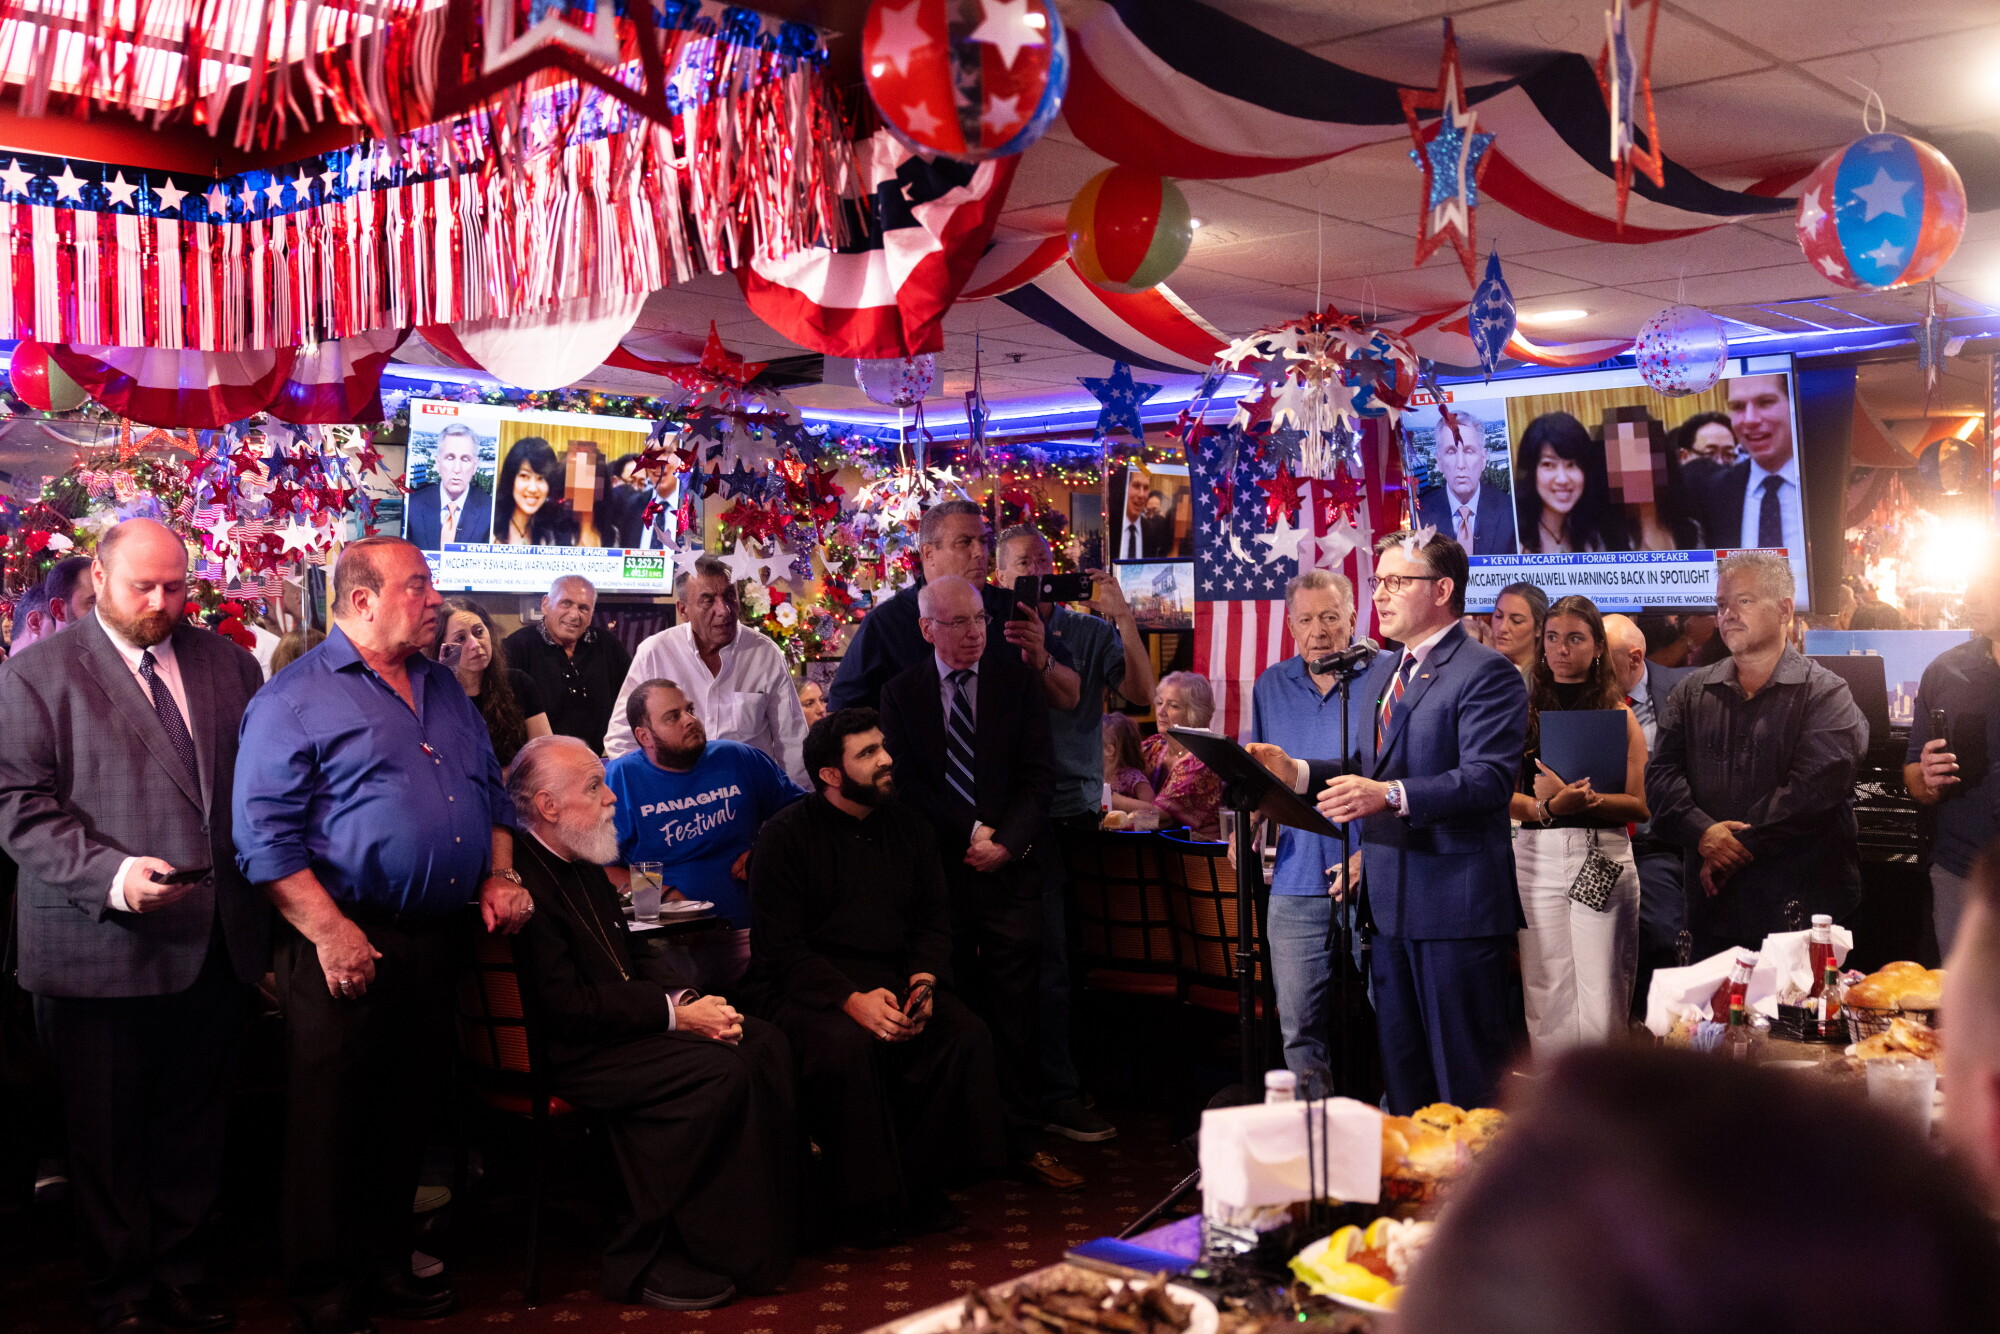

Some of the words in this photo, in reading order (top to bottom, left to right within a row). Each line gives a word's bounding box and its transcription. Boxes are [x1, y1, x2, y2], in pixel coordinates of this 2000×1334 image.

[426, 405, 455, 415] LIVE
[467, 544, 490, 553] KEVIN
[492, 545, 532, 554] MCCARTHY
[538, 547, 561, 555] FORMER
[562, 548, 582, 556] HOUSE
[583, 549, 608, 557] SPEAKER
[626, 558, 663, 569] 53,252.72
[1491, 556, 1519, 565] KEVIN
[1522, 555, 1574, 564] MCCARTHY
[1582, 554, 1616, 563] FORMER
[1619, 553, 1649, 562] HOUSE
[1651, 553, 1689, 562] SPEAKER
[489, 559, 522, 570] SWALWELL
[525, 560, 559, 571] WARNINGS
[561, 561, 578, 572] BACK
[581, 562, 587, 572] IN
[588, 562, 619, 573] SPOTLIGHT
[1468, 573, 1519, 586] MCCARTHY'S
[1521, 572, 1566, 586] SWALWELL
[1568, 571, 1618, 585] WARNINGS
[1621, 571, 1645, 585] BACK
[1648, 571, 1658, 585] IN
[1660, 570, 1710, 584] SPOTLIGHT
[1479, 597, 1497, 605] DRIN
[1684, 595, 1717, 603] WOMEN
[640, 785, 741, 816] PANAGHIA
[659, 799, 737, 847] Festival
